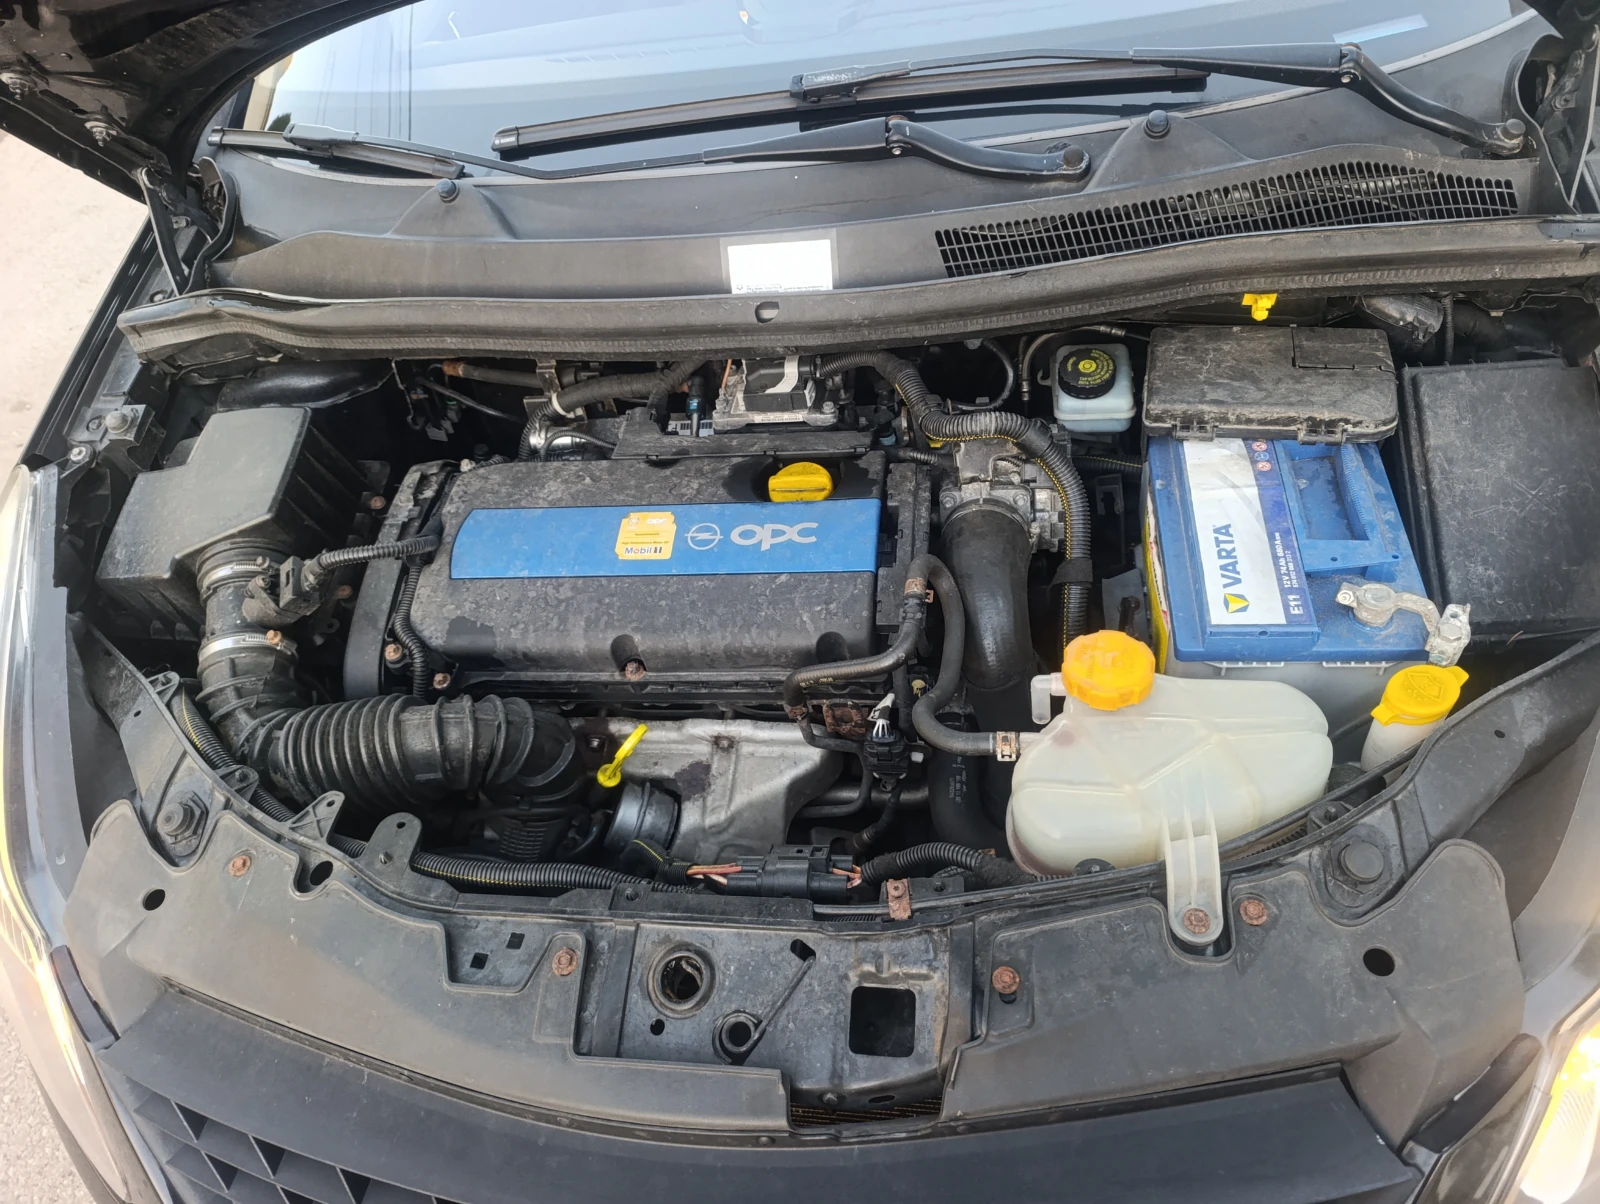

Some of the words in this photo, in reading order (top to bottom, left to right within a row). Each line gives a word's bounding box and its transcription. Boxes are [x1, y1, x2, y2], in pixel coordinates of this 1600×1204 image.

[624, 546, 652, 554] Mobil
[1212, 523, 1242, 589] VARTA
[1278, 557, 1288, 574] 74Ah
[1283, 576, 1291, 588] 12V
[1287, 594, 1304, 614] E11
